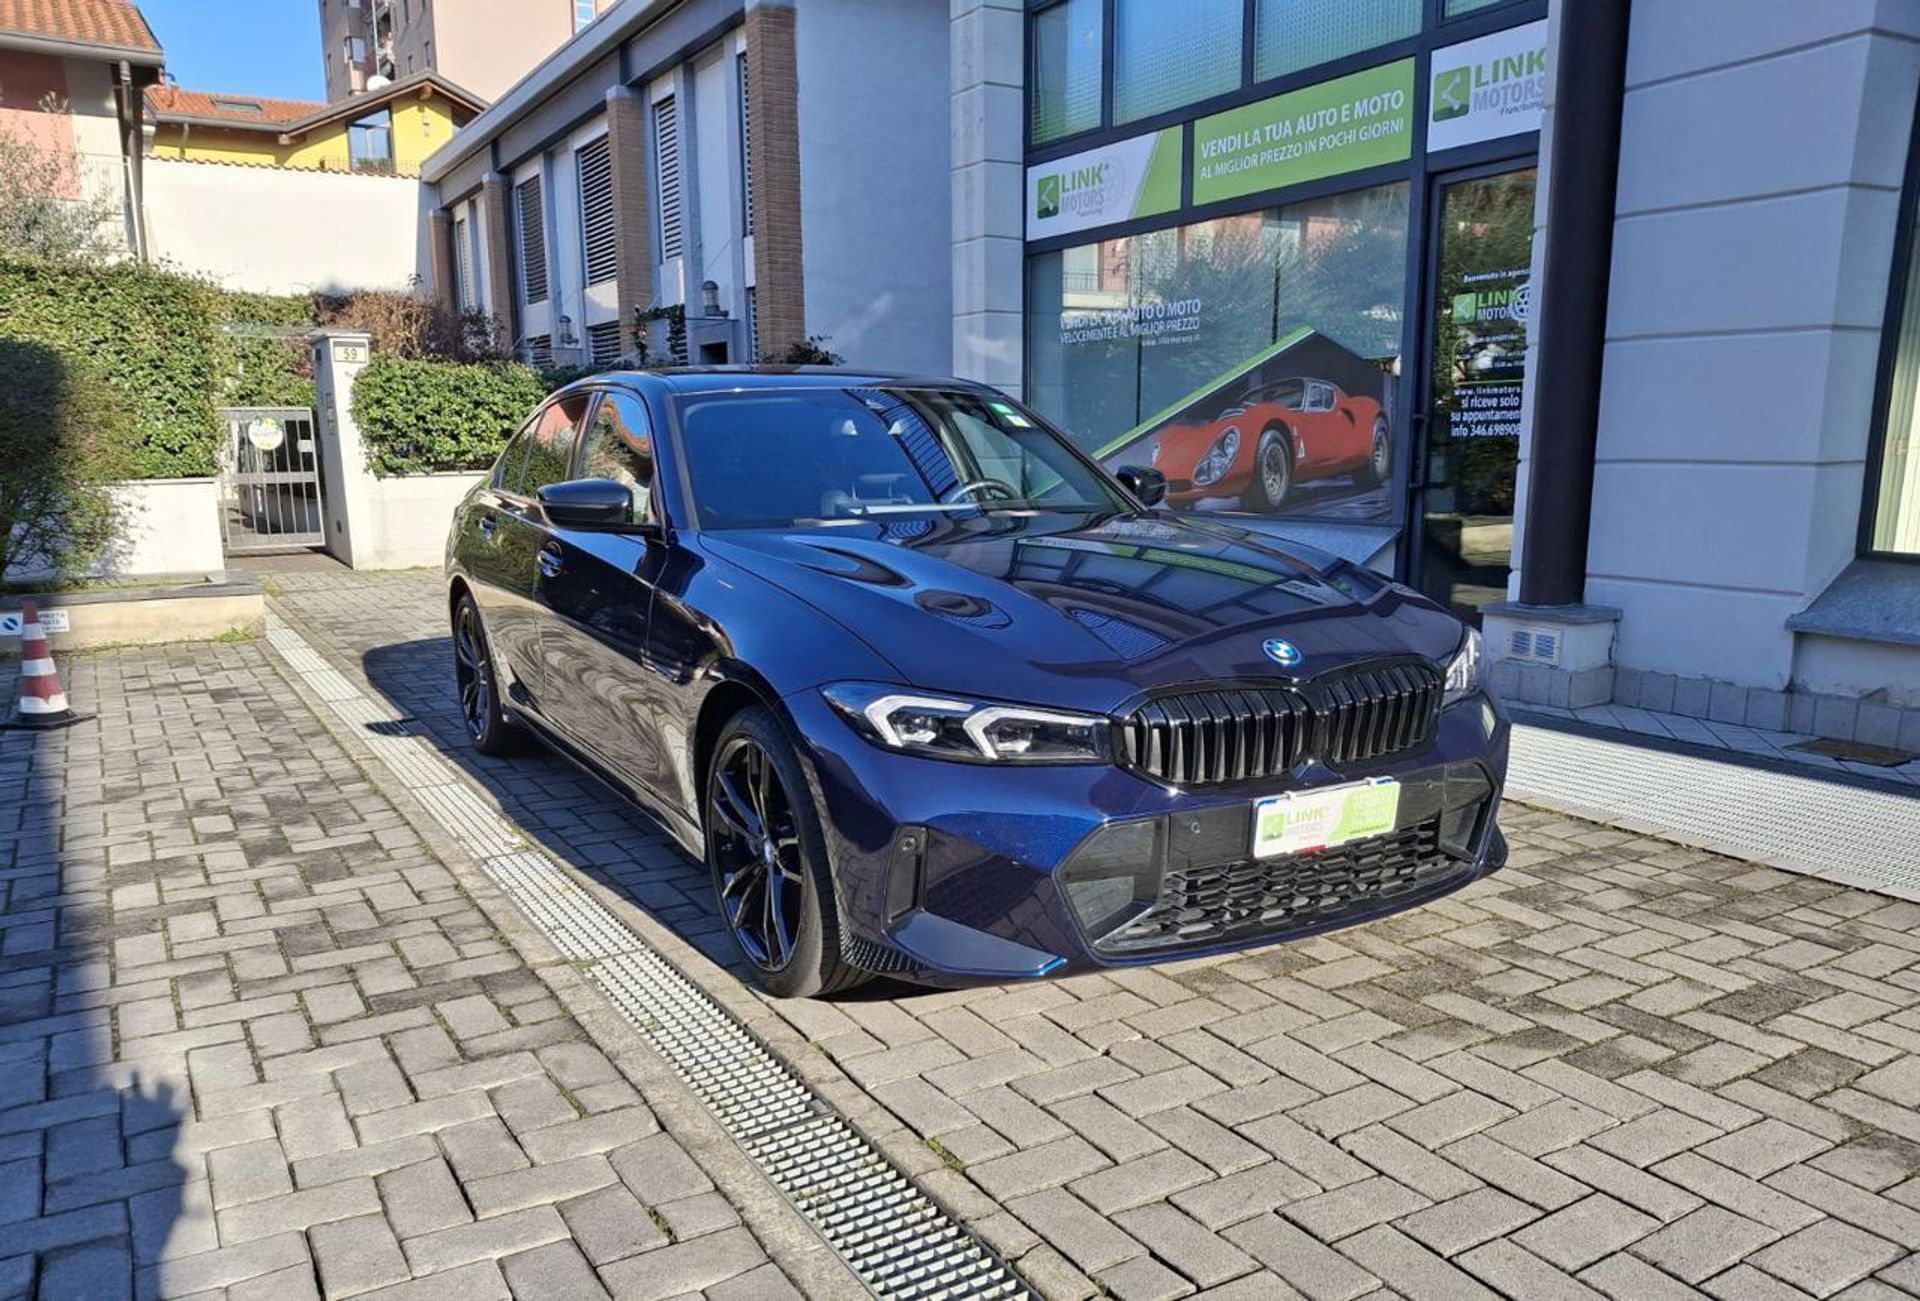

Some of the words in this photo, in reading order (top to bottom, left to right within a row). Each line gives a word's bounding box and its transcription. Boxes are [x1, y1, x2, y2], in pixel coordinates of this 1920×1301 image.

[1474, 48, 1546, 88] LINK
[1473, 76, 1545, 113] MOTORS
[1201, 132, 1241, 159] VENDI
[1244, 128, 1261, 149] LA
[1263, 119, 1293, 142] TUA
[1296, 106, 1338, 134] AUTO
[1341, 103, 1350, 123] E
[1354, 89, 1404, 120] MOTO
[1200, 165, 1213, 181] AL
[1215, 153, 1258, 176] MIGLIOR
[1260, 142, 1302, 166] PREZZO
[1304, 139, 1317, 155] IN
[1319, 127, 1355, 152] POCHI
[1359, 117, 1404, 141] GIORNI
[1061, 161, 1104, 193] LINK
[1060, 189, 1105, 214] MOTORS
[1122, 304, 1154, 322] AUTO
[1156, 304, 1165, 318] O
[1167, 298, 1201, 315] MOTO
[1477, 306, 1512, 321] MOTO
[1130, 320, 1166, 336] MIGLIOR
[1167, 317, 1200, 332] PREZZO
[343, 348, 358, 361] 59
[1454, 386, 1522, 396] www.linkmotors.
[1461, 396, 1468, 408] si
[1470, 396, 1498, 408] riceve
[1500, 394, 1519, 407] solo
[1451, 411, 1460, 421] su
[1462, 409, 1521, 424] appuntamen
[1451, 424, 1468, 437] info
[1470, 423, 1521, 437] 346.698908
